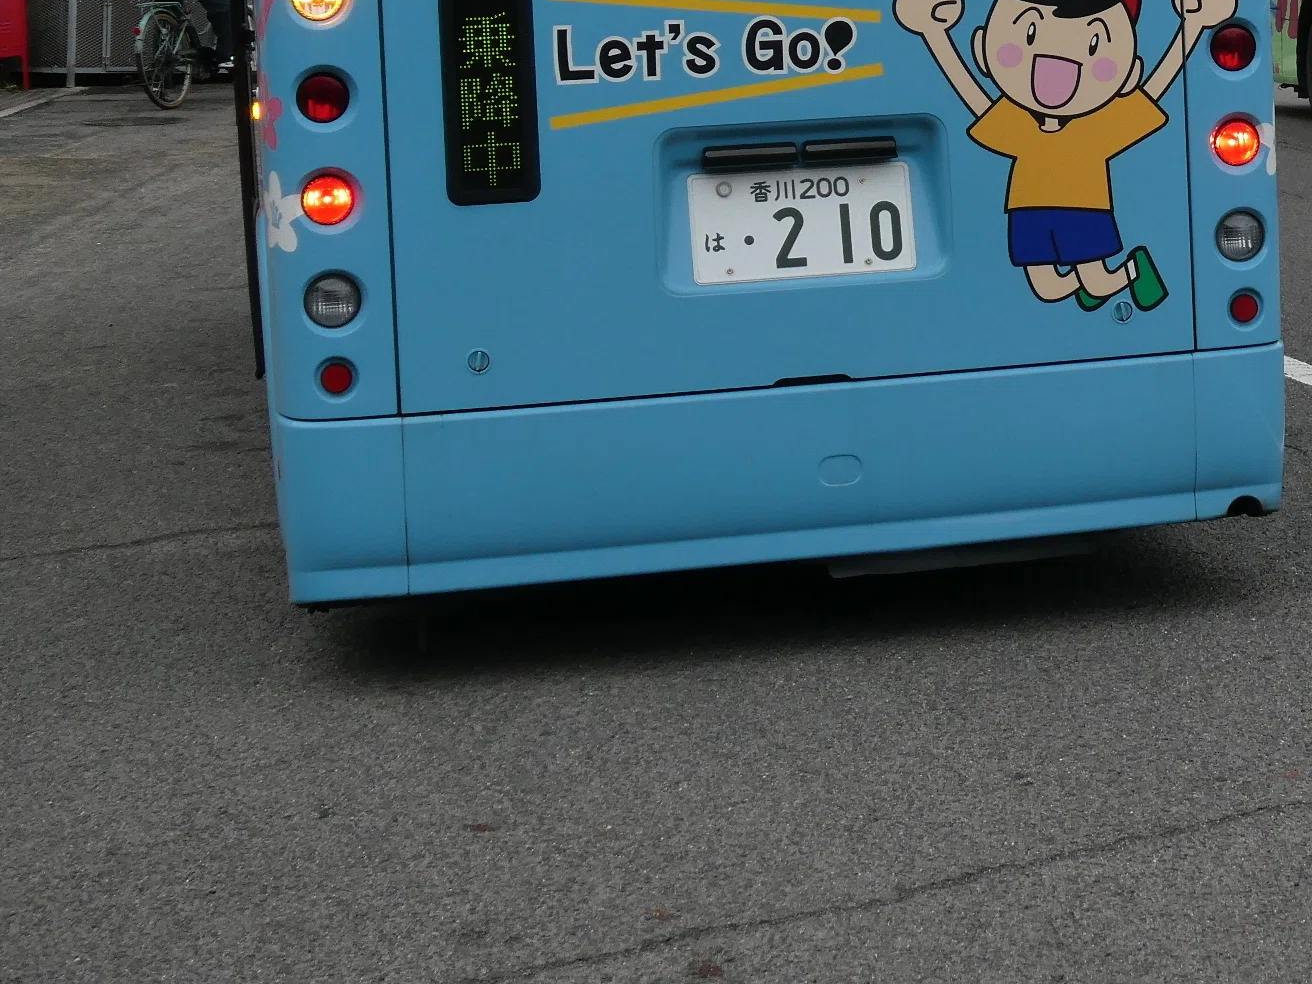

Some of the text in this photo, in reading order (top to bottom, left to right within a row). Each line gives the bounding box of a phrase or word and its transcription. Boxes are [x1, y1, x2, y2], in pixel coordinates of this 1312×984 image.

[553, 15, 857, 85] Let's Go!
[457, 11, 522, 187] 乗降中
[705, 232, 726, 253] は
